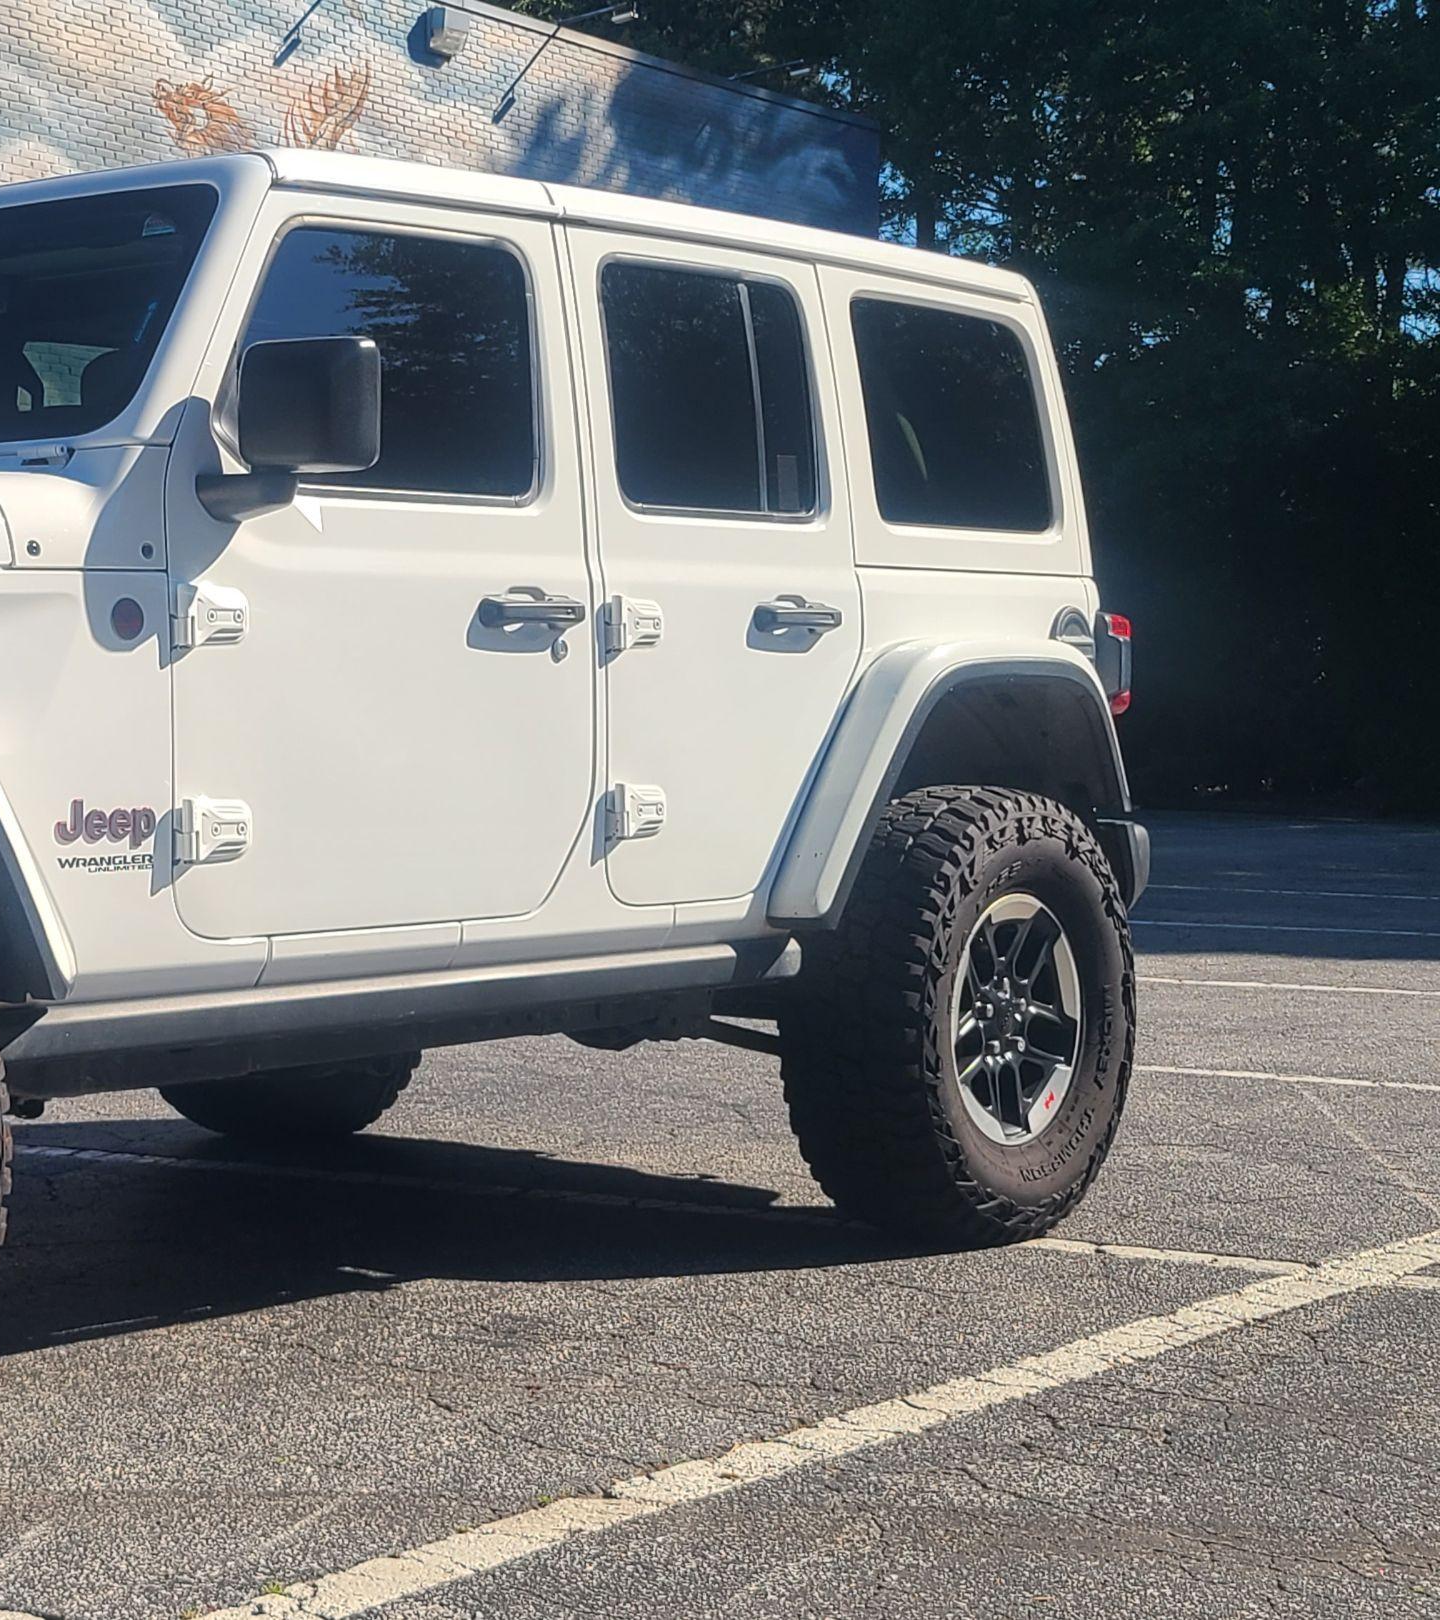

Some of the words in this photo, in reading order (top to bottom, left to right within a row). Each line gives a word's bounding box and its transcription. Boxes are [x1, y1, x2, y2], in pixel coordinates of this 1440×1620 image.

[54, 799, 157, 850] Jeep
[57, 854, 153, 869] WRANGLER
[88, 864, 154, 873] UNLIMITED
